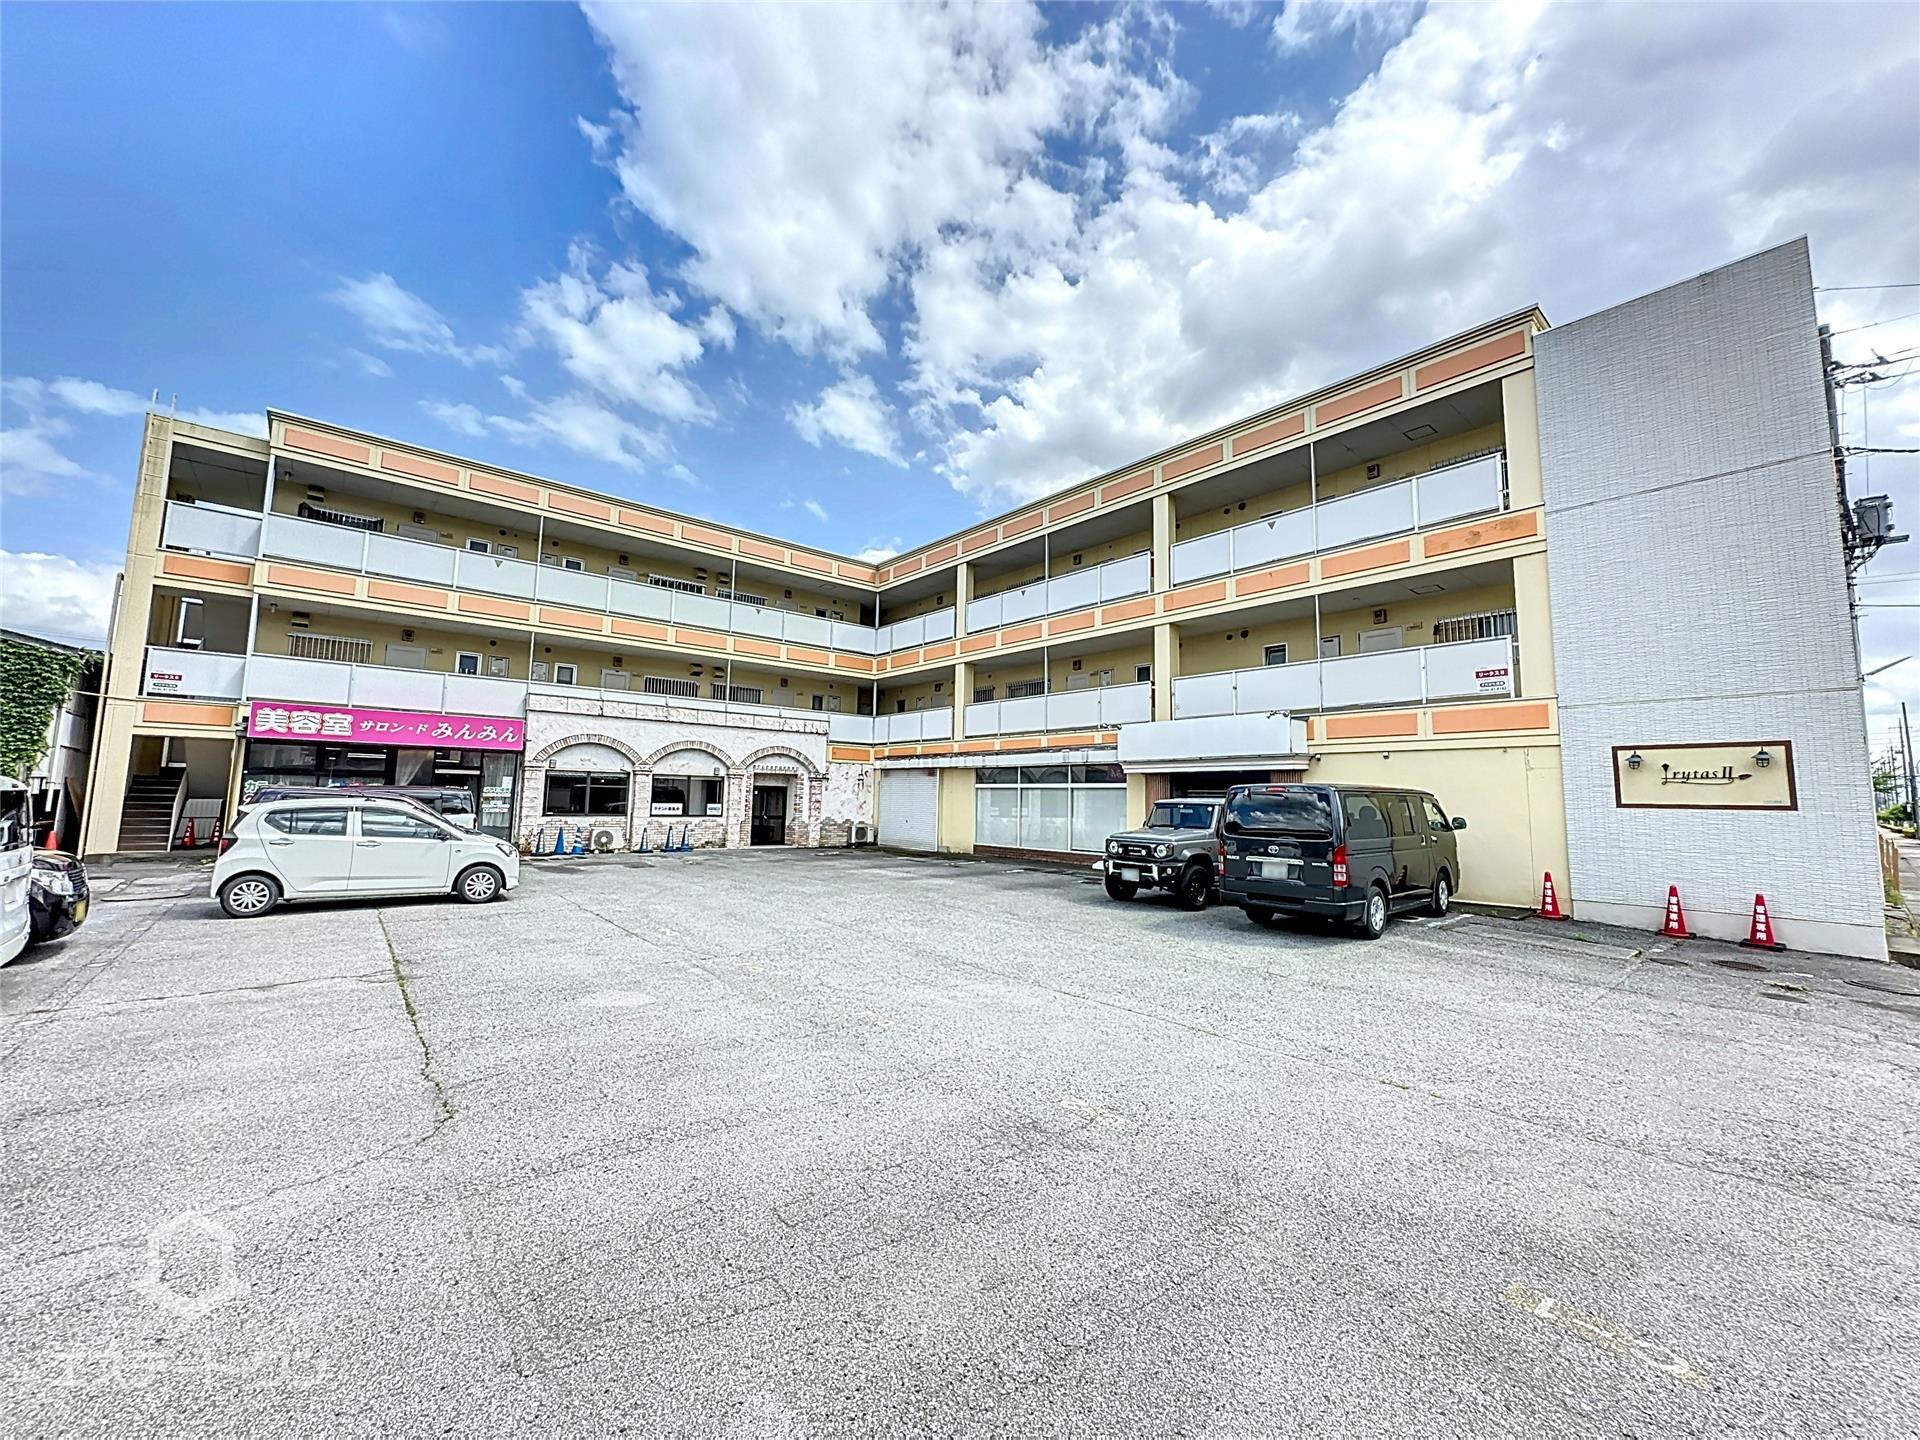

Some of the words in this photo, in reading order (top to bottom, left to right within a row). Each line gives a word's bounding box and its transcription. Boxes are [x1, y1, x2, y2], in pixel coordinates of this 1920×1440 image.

[254, 707, 354, 737] 美容室
[359, 720, 429, 735] サロン・ド
[431, 721, 519, 743] みんみん
